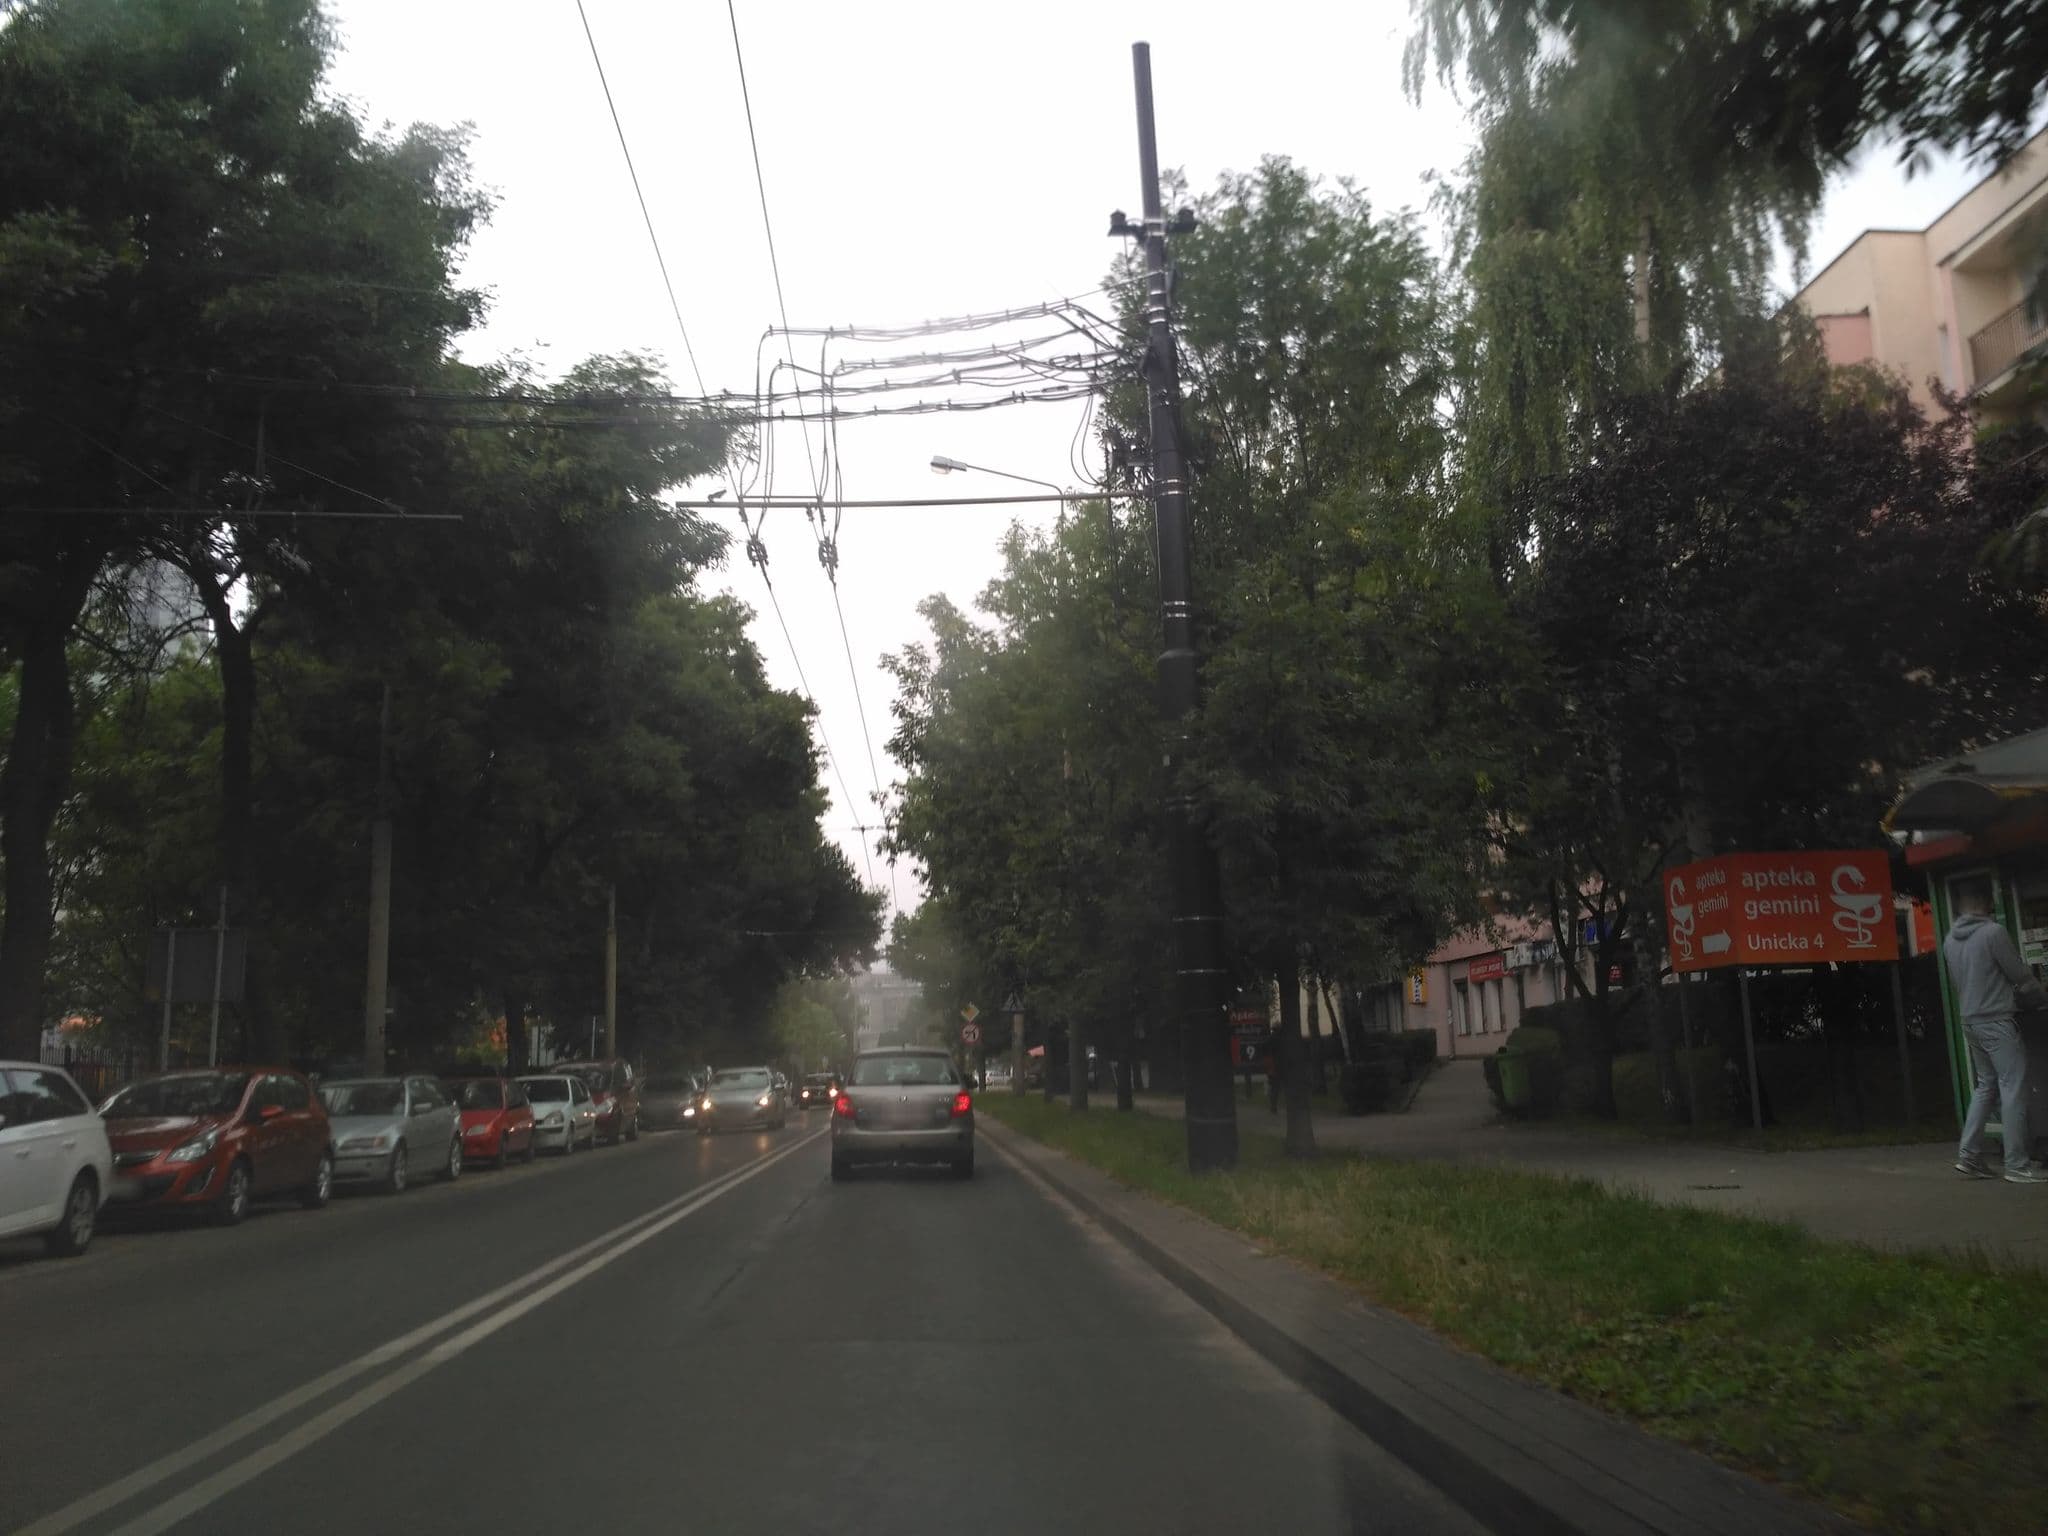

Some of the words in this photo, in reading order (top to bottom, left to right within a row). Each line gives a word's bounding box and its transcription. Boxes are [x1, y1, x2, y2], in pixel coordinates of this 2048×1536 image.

[1695, 866, 1726, 892] apteka
[1742, 866, 1816, 891] apteka
[1697, 892, 1728, 918] gemini
[1744, 894, 1820, 920] gemini
[1747, 933, 1808, 950] Unicka
[1813, 933, 1825, 949] 4
